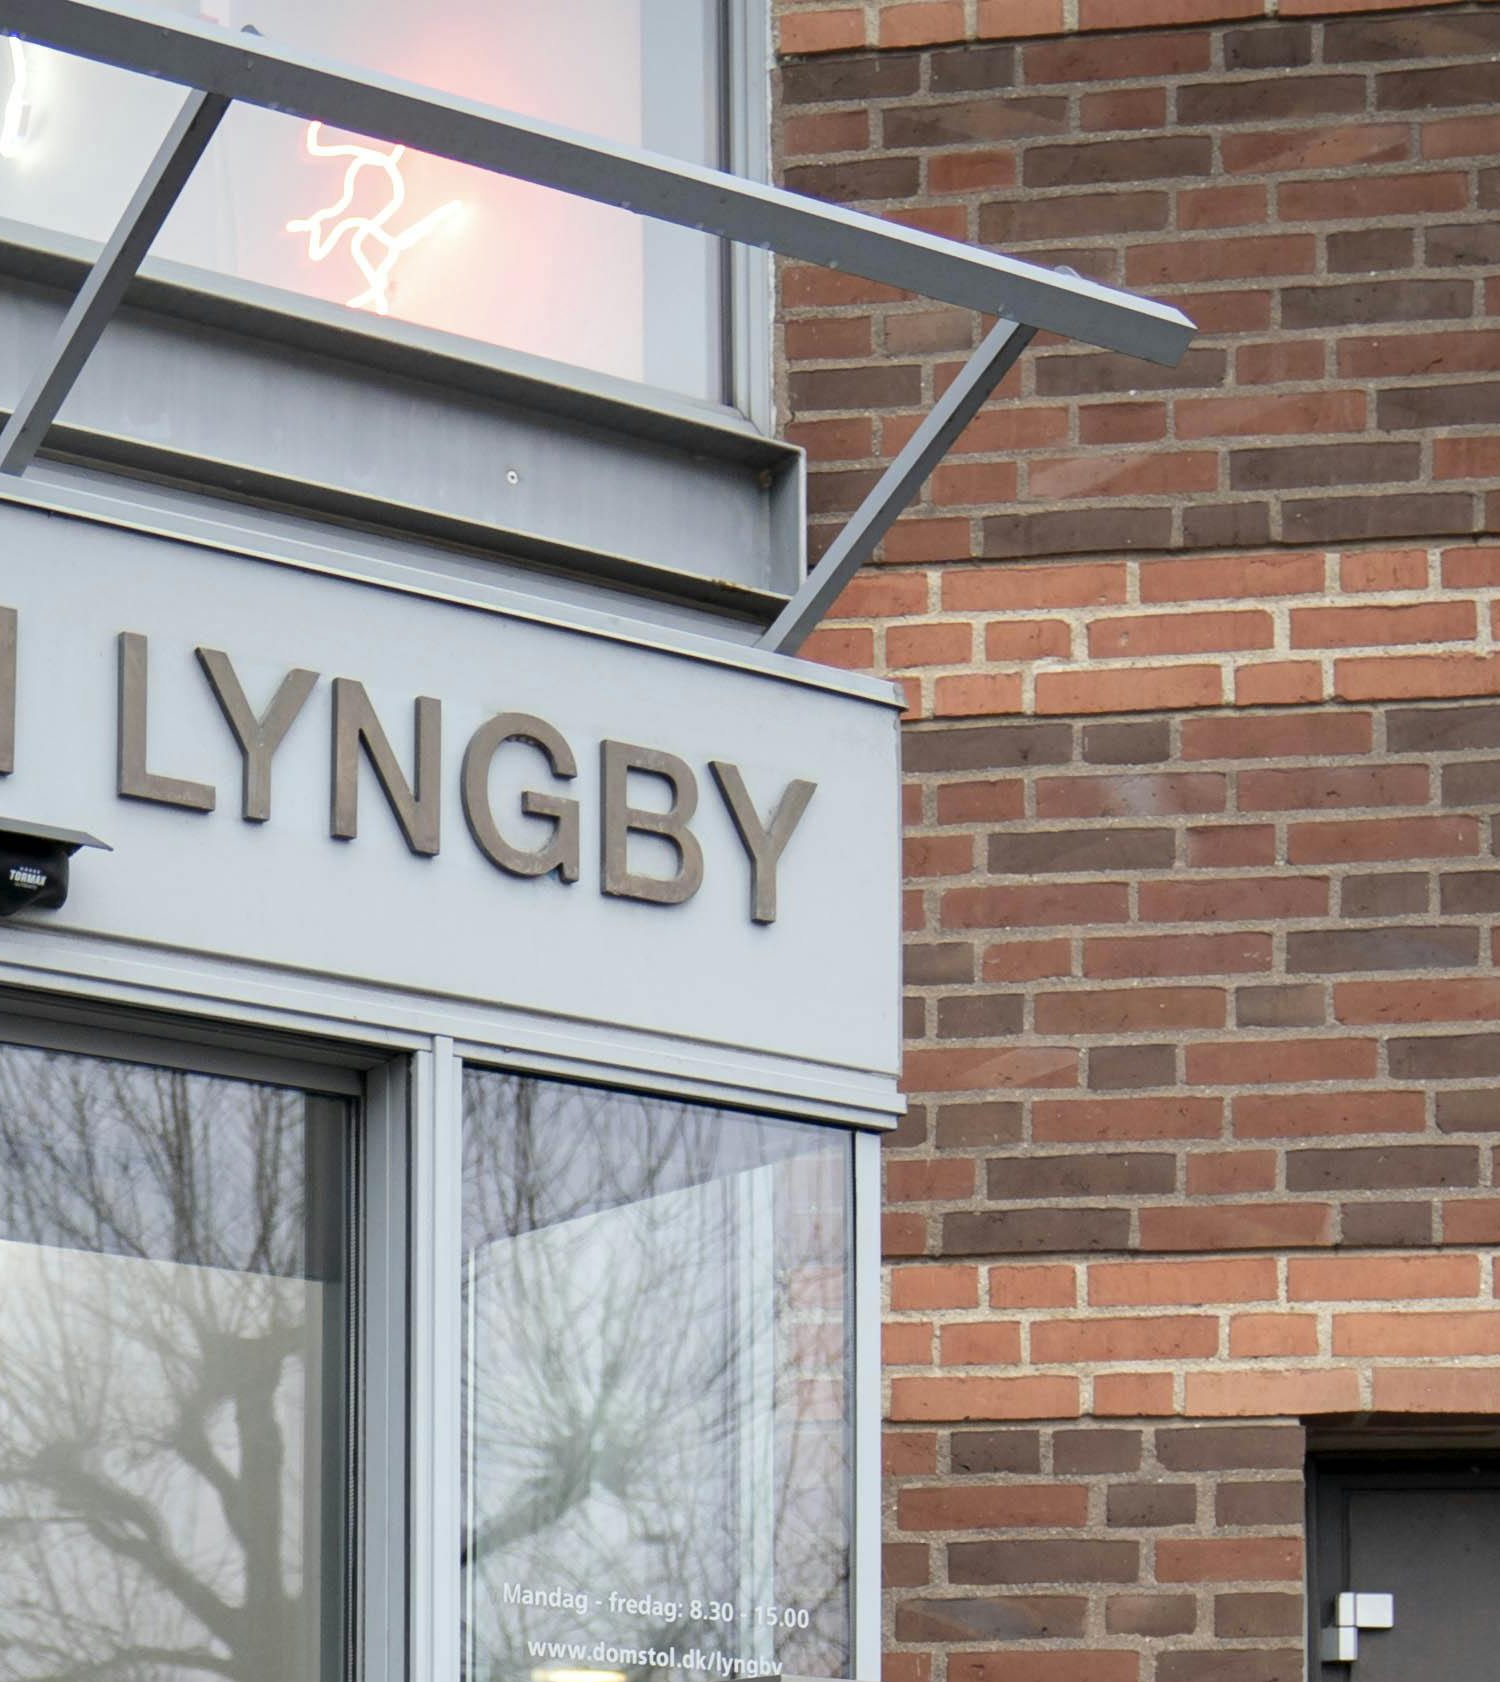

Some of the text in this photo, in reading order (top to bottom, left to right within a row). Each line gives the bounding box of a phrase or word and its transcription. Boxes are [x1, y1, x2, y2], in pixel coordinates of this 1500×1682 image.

[115, 631, 818, 925] LYNGBY
[502, 1583, 588, 1615] Mandag
[608, 1590, 684, 1624] fredag:
[689, 1600, 734, 1622] 8.30
[755, 1605, 810, 1629] 15.00
[527, 1638, 783, 1678] www.domstol.dk/lyngby
